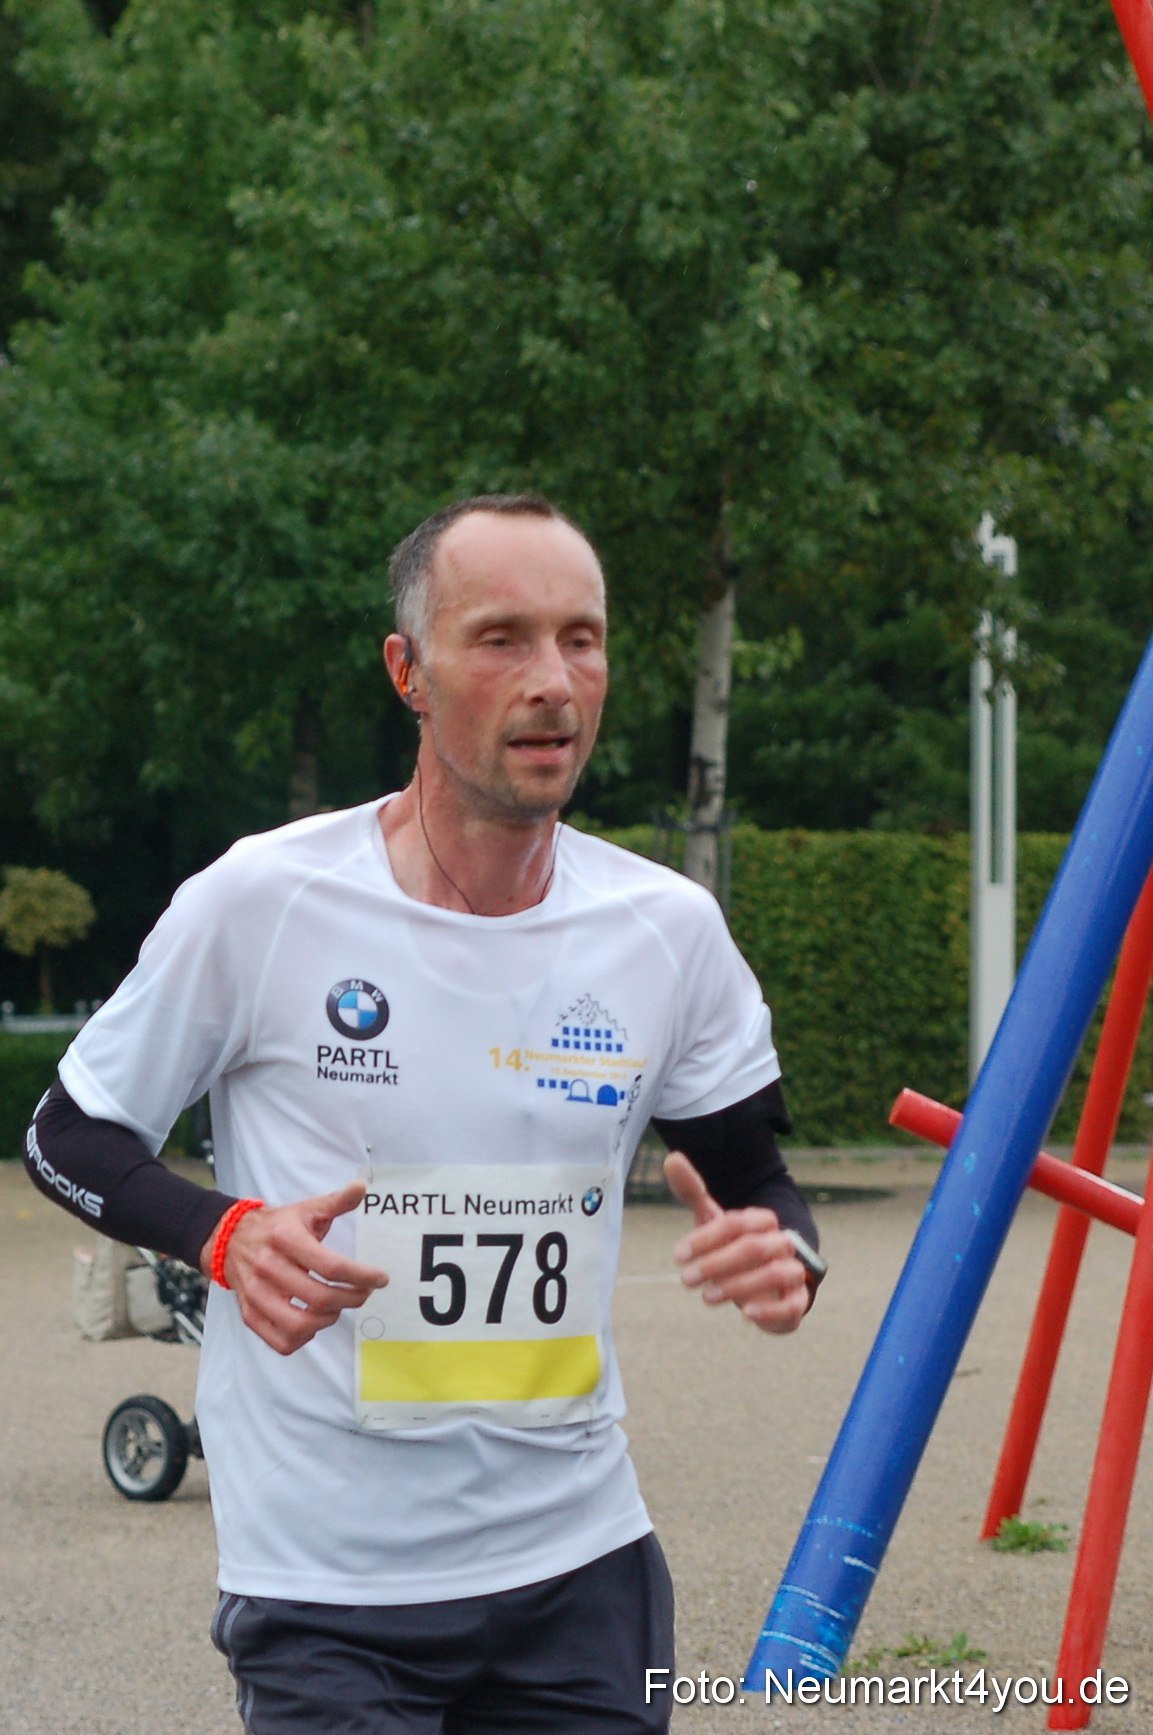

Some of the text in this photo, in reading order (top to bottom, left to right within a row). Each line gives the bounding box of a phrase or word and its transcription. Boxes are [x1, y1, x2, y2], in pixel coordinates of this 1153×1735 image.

[317, 1045, 399, 1070] PARTL
[488, 1046, 531, 1072] 14.
[317, 1066, 398, 1086] Neumarkt
[363, 1192, 574, 1216] PARTL Neumarkt
[418, 1231, 569, 1326] 578
